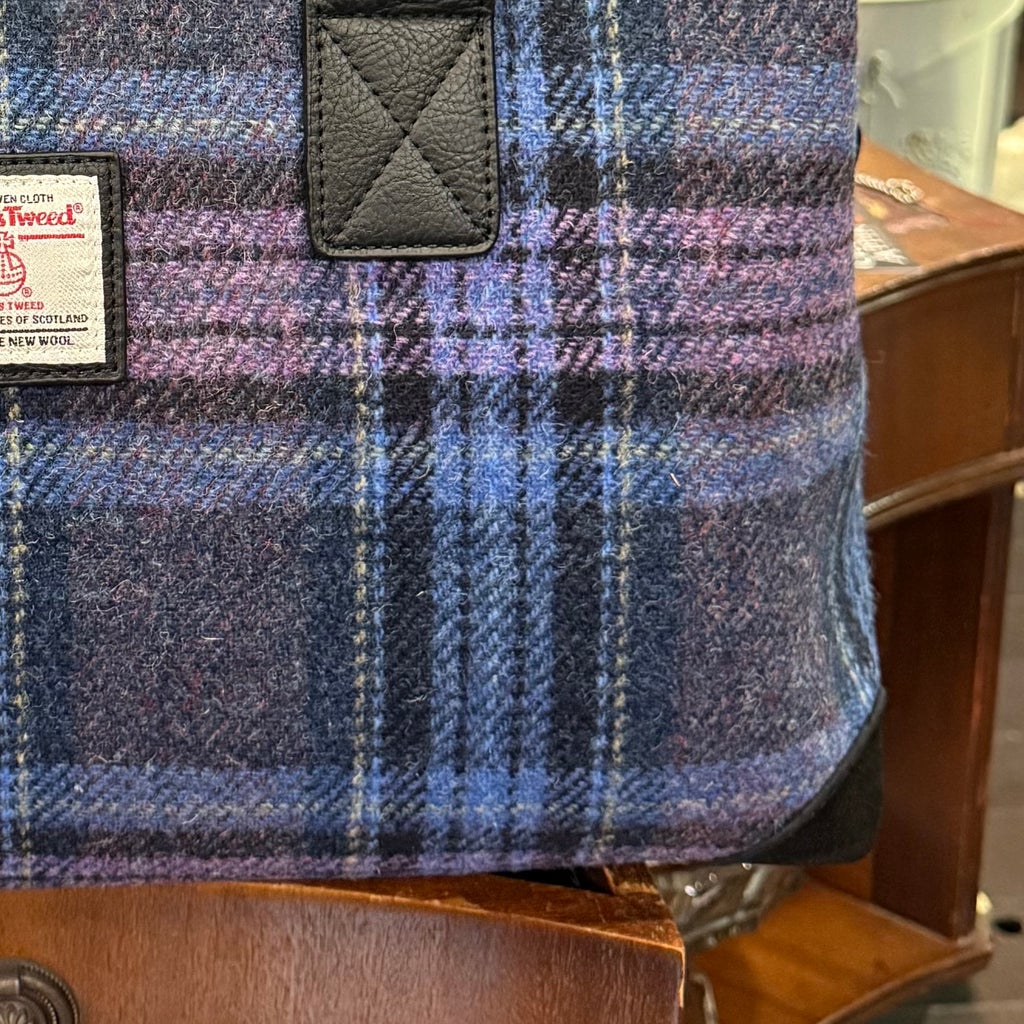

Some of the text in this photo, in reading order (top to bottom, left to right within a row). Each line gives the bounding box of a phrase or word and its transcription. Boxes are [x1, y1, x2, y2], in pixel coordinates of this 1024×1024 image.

[20, 193, 54, 203] CLOTH
[8, 301, 44, 311] TWEED
[15, 315, 29, 325] OF
[32, 314, 89, 324] SCOTLAND
[8, 336, 38, 347] NEW
[39, 335, 75, 346] WOOL
